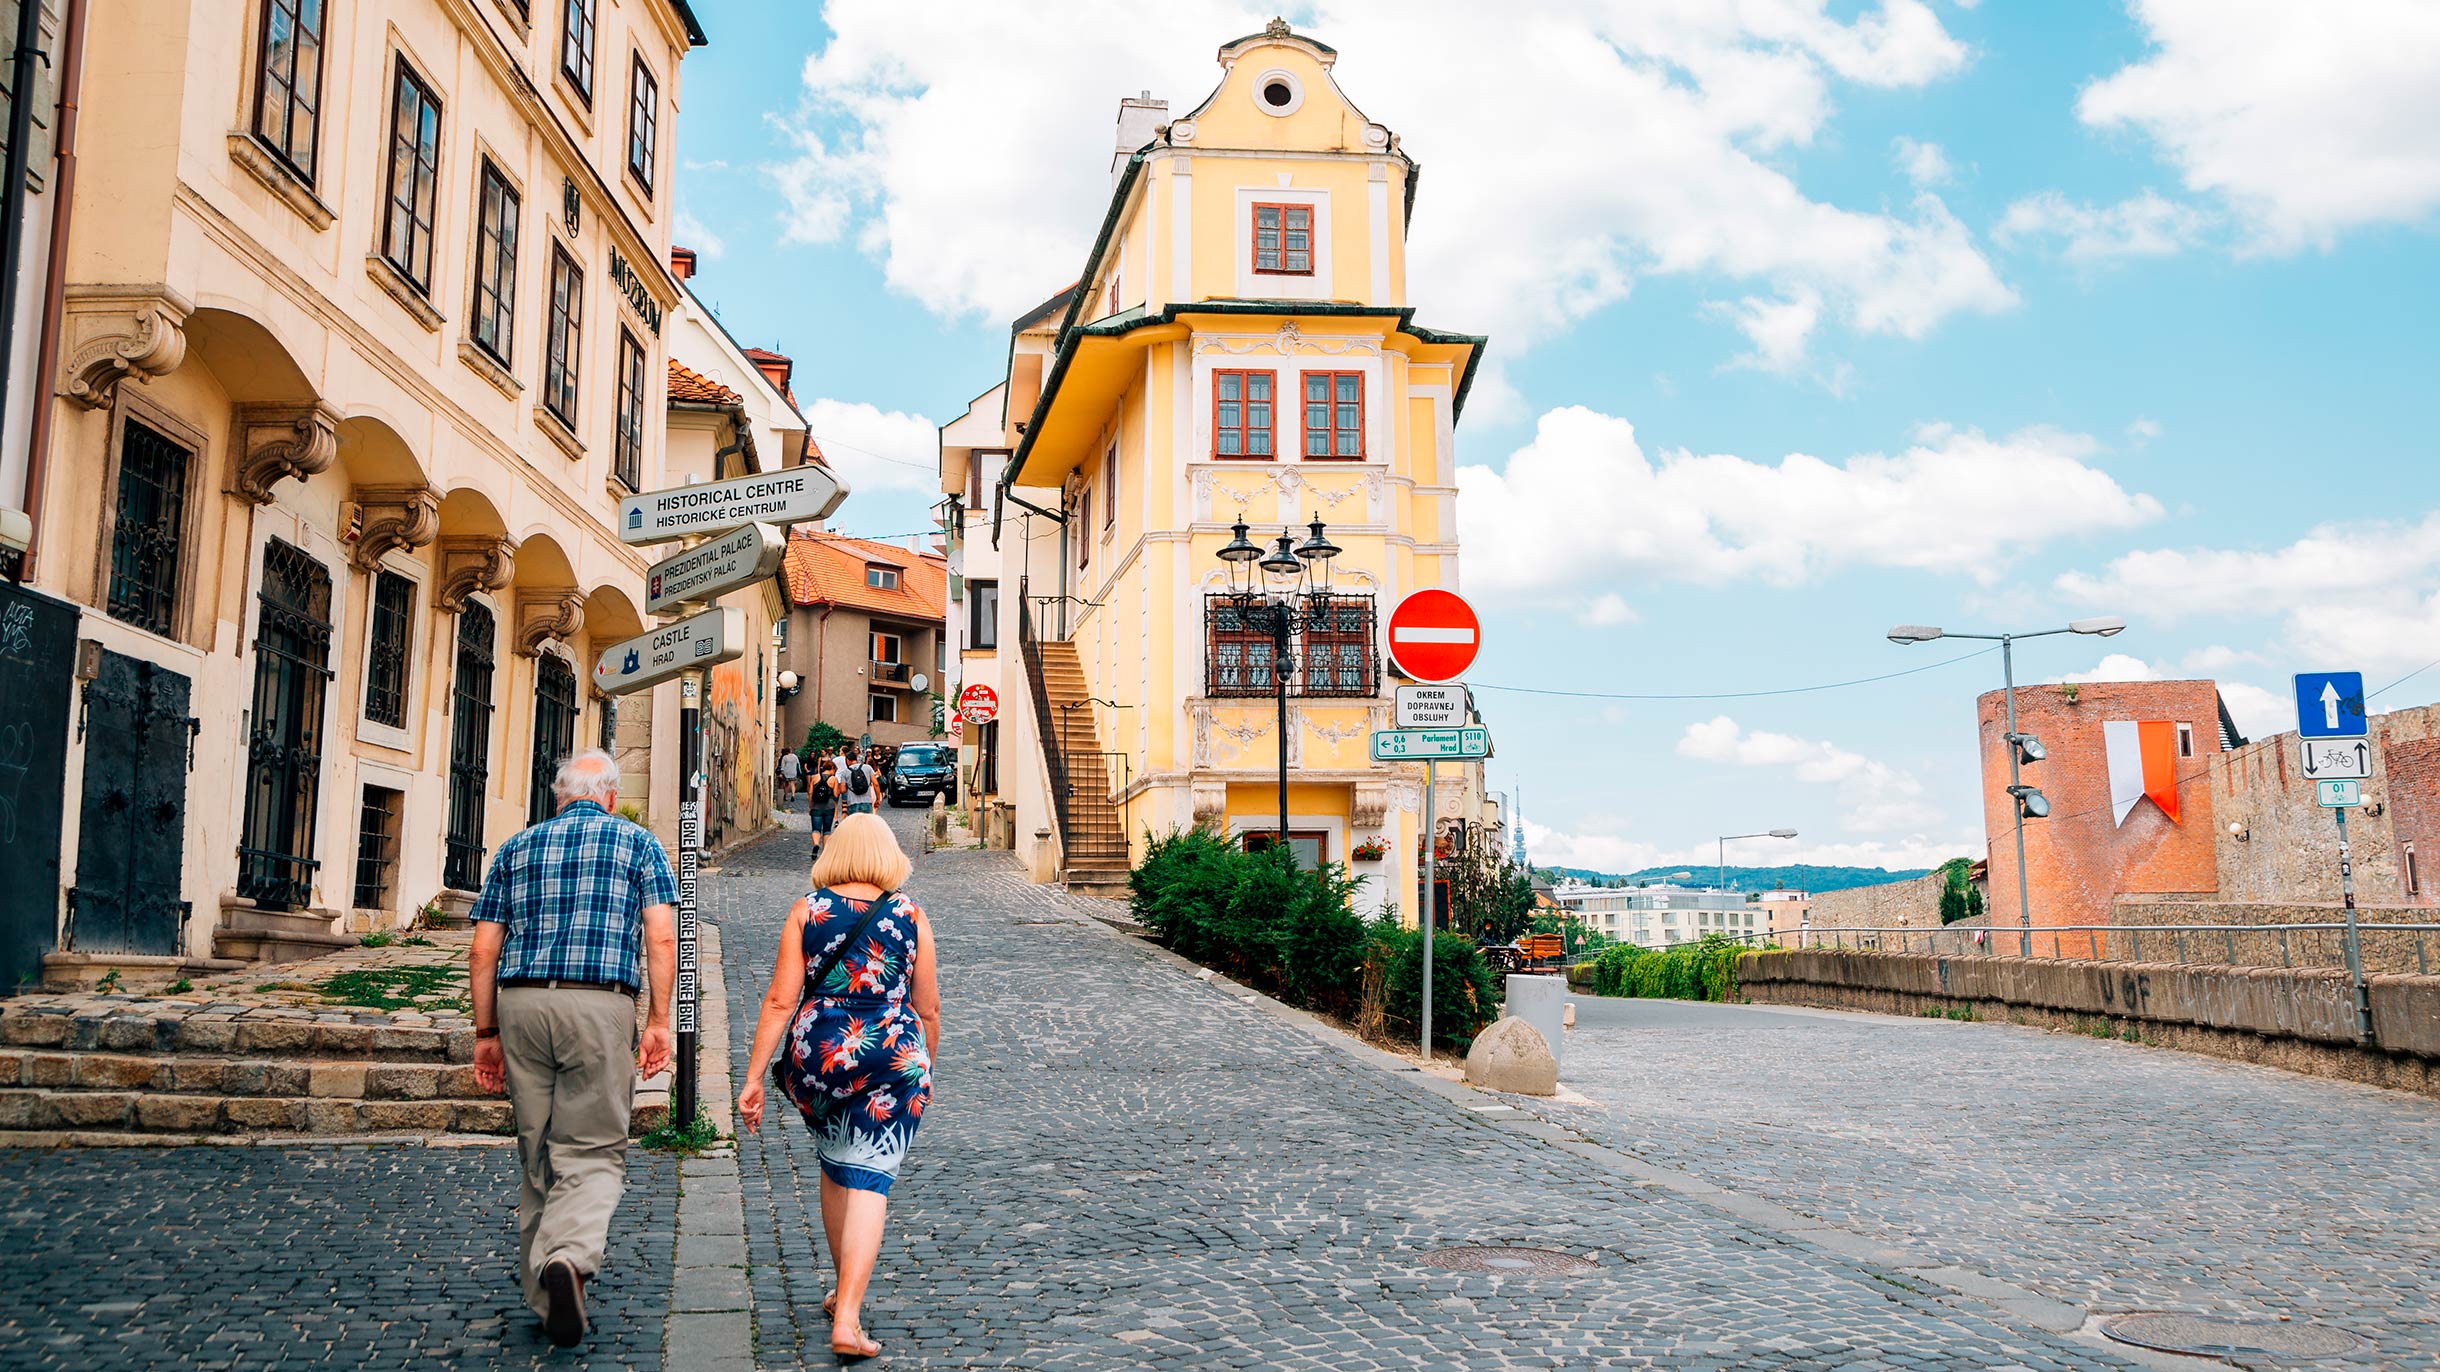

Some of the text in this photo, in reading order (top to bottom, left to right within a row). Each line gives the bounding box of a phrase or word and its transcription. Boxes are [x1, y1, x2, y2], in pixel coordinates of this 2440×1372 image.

[657, 478, 804, 511] HISTORICAL CENTRE
[656, 500, 787, 528] HISTORICKÉ CENTRUM
[664, 533, 753, 581] PREZIDENTIAL PALACE
[664, 559, 737, 598] PREZIDENTSKÝ PALÁC
[652, 625, 690, 651] CASTLE
[652, 650, 675, 668] HRAD
[1407, 702, 1454, 711] DOPRAVNEJ
[1416, 691, 1445, 699] OKREM
[1412, 713, 1449, 722] OBSLUHY
[1393, 735, 1406, 744] 0,6
[1422, 733, 1457, 742] Parlament
[1393, 744, 1457, 753] 0,3 Hrad
[683, 822, 696, 846] BNE
[682, 853, 695, 878] BNE
[681, 882, 695, 906] BNE
[681, 912, 695, 937] BNE
[681, 943, 694, 968] BNE
[680, 974, 693, 999] BNE
[679, 1006, 693, 1031] BNE
